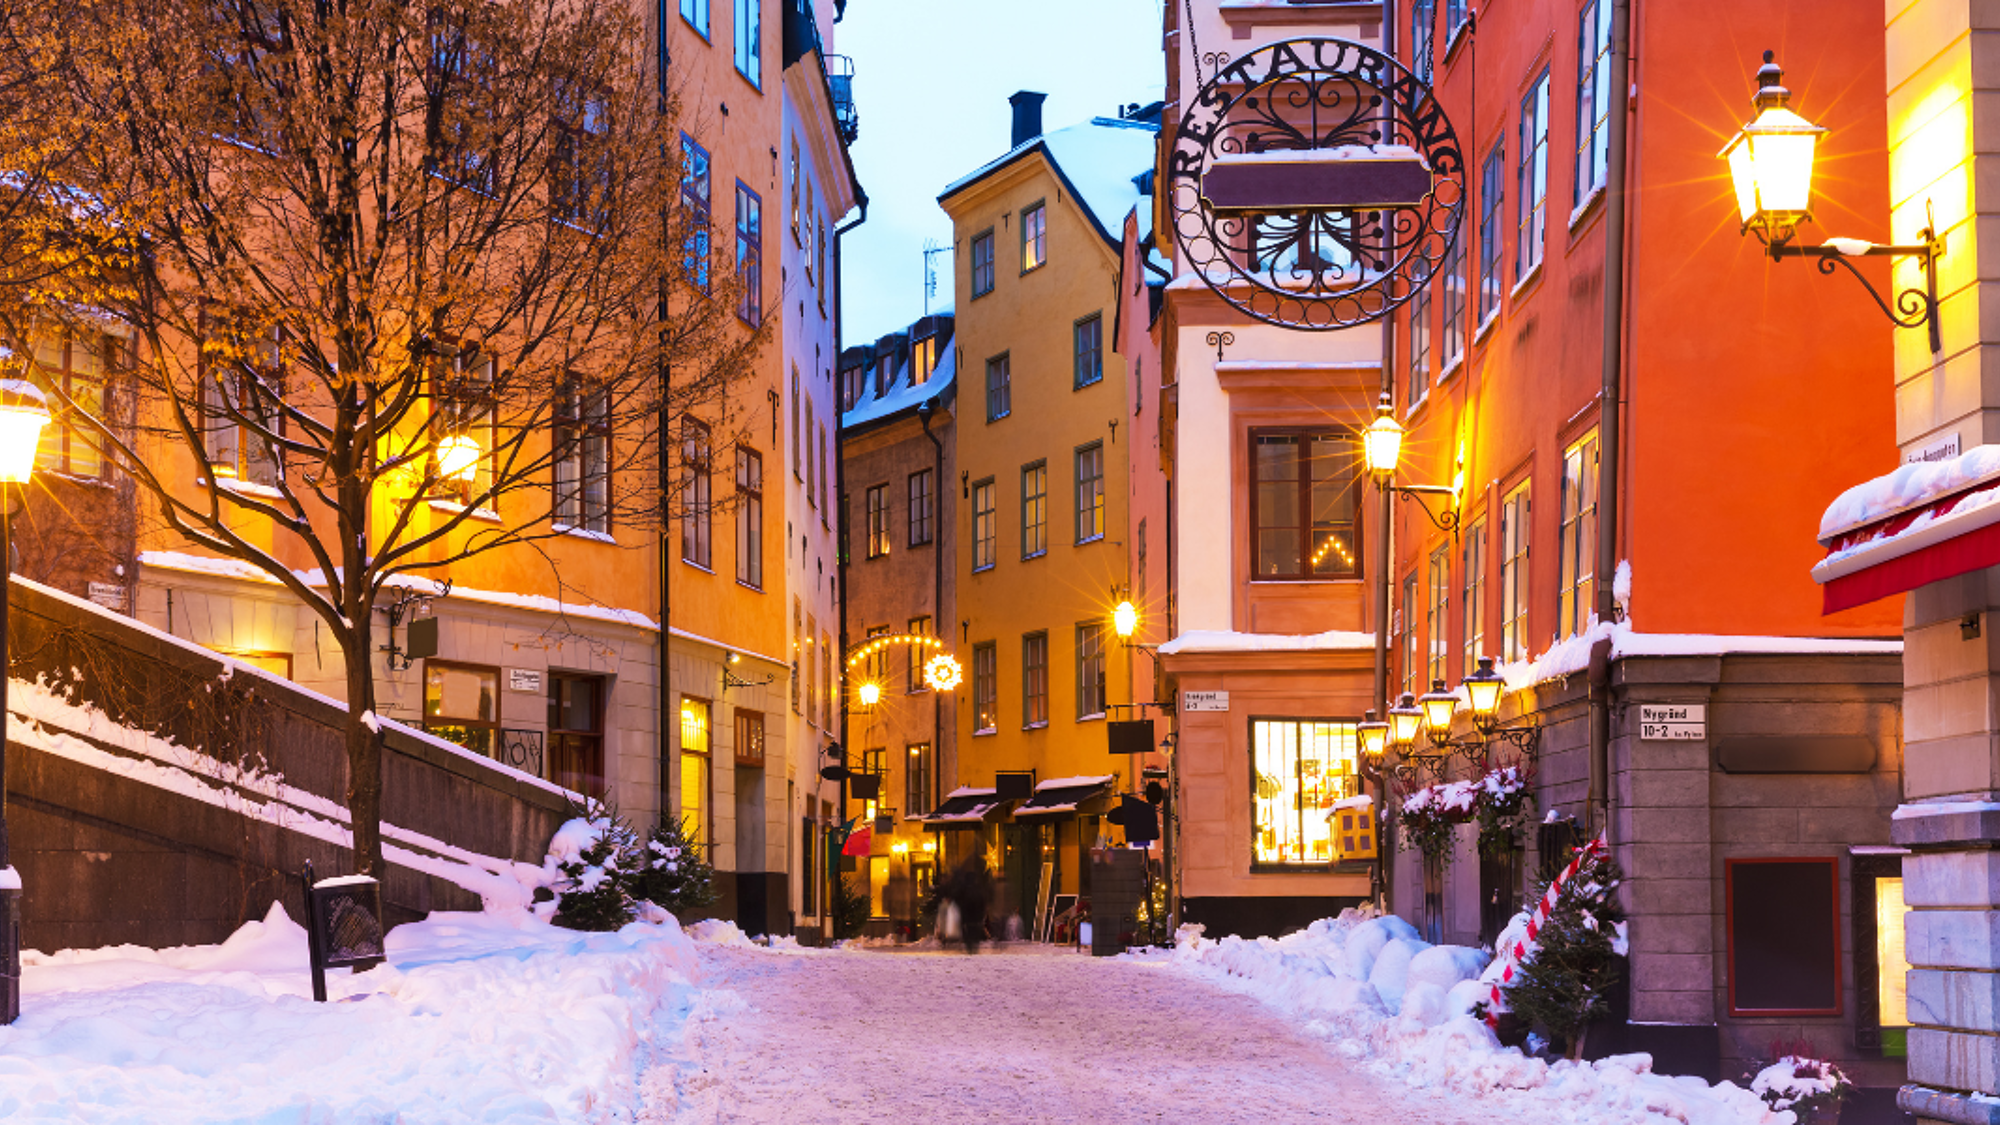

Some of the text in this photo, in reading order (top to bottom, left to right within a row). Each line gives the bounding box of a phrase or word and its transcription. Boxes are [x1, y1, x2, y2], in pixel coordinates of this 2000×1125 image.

[1172, 40, 1462, 182] RESTAURANG
[1643, 708, 1687, 722] Nygränd
[1643, 725, 1669, 738] 10-2
